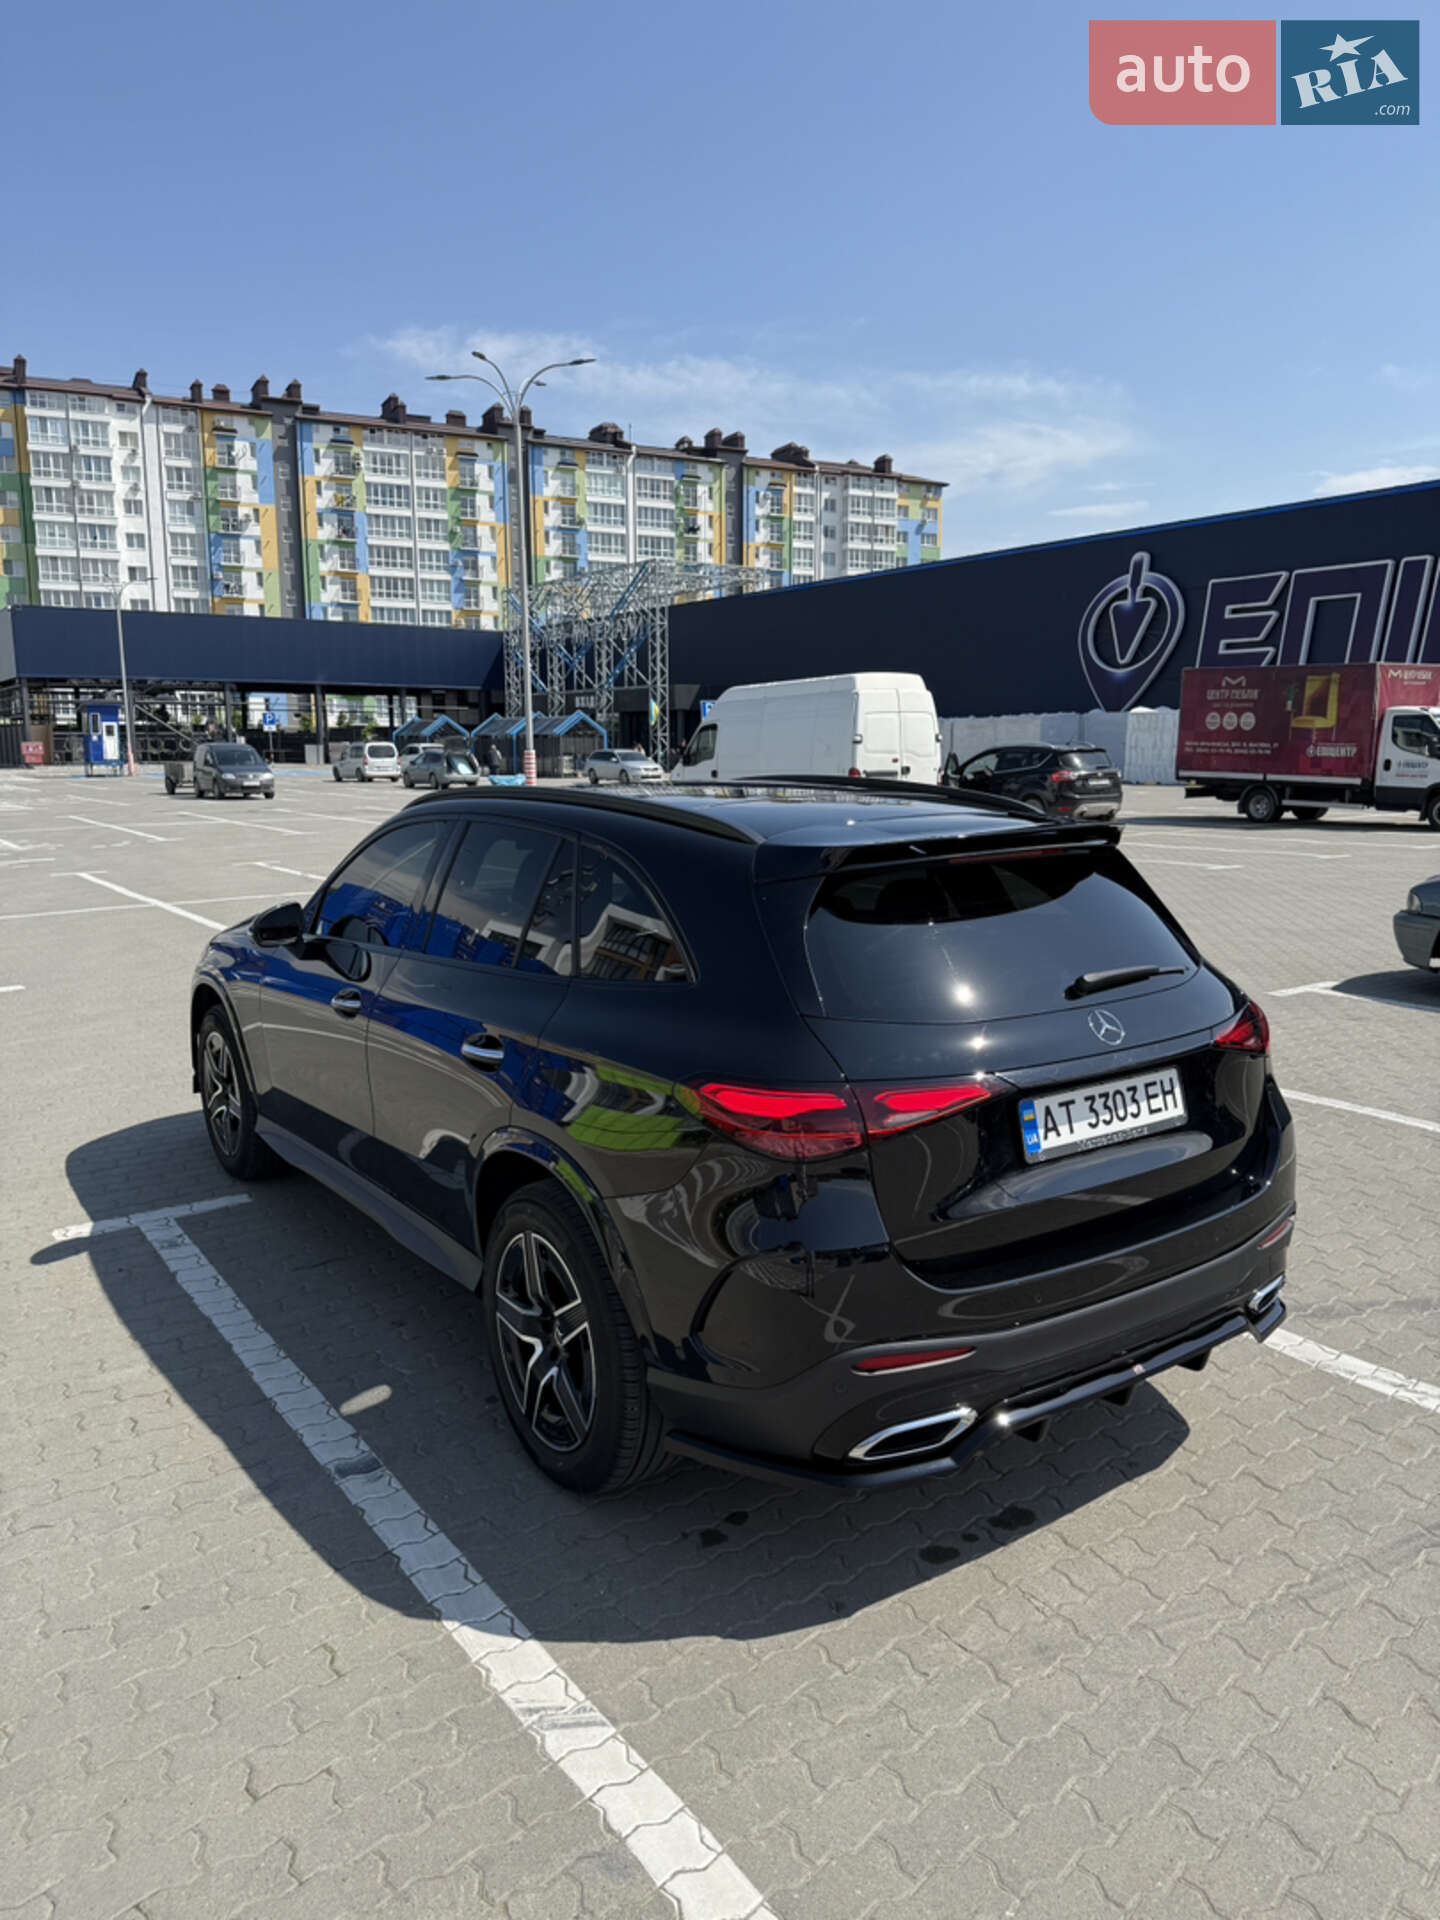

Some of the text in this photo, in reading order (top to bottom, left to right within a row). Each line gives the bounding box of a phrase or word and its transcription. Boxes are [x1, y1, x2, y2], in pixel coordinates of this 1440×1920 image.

[1196, 555, 1440, 668] ЕПІ
[1027, 1133, 1039, 1145] UA
[1043, 1077, 1178, 1141] AT 3303 EH
